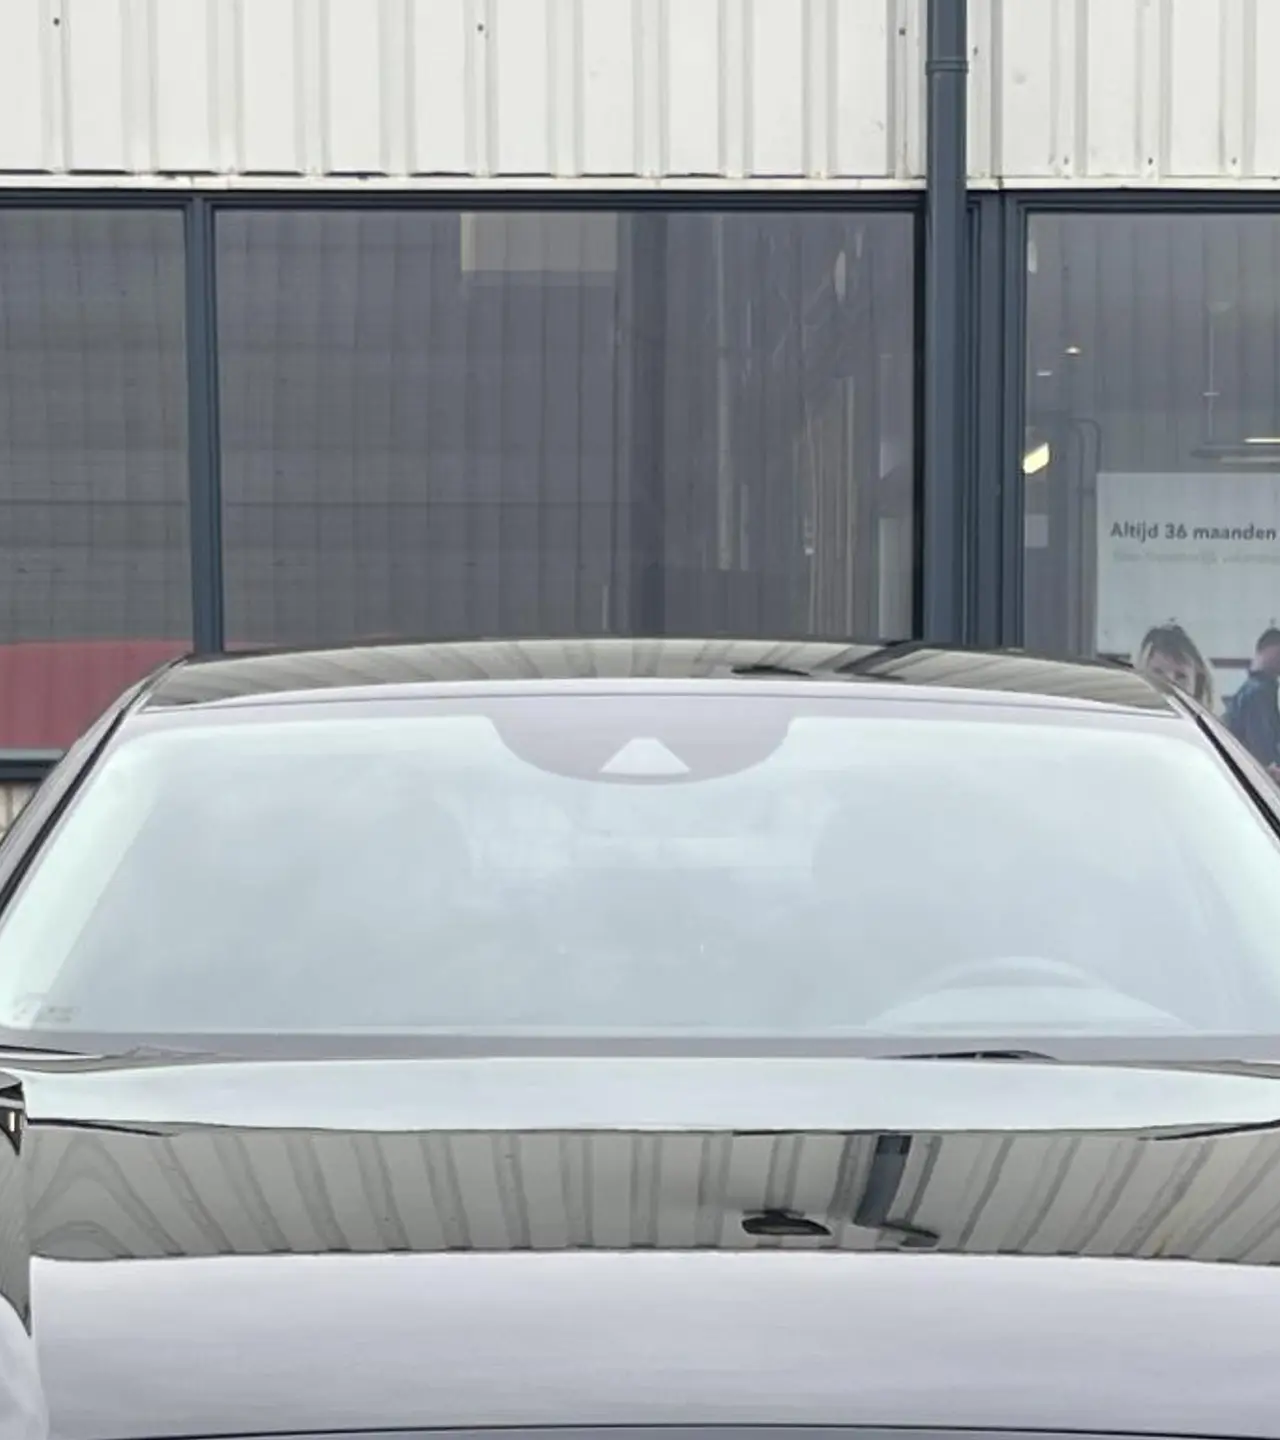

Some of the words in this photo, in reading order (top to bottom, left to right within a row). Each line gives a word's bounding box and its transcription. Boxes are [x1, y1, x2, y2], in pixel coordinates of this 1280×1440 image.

[1110, 521, 1159, 543] Altijd
[1165, 523, 1187, 541] 36
[1193, 523, 1277, 542] maanden
